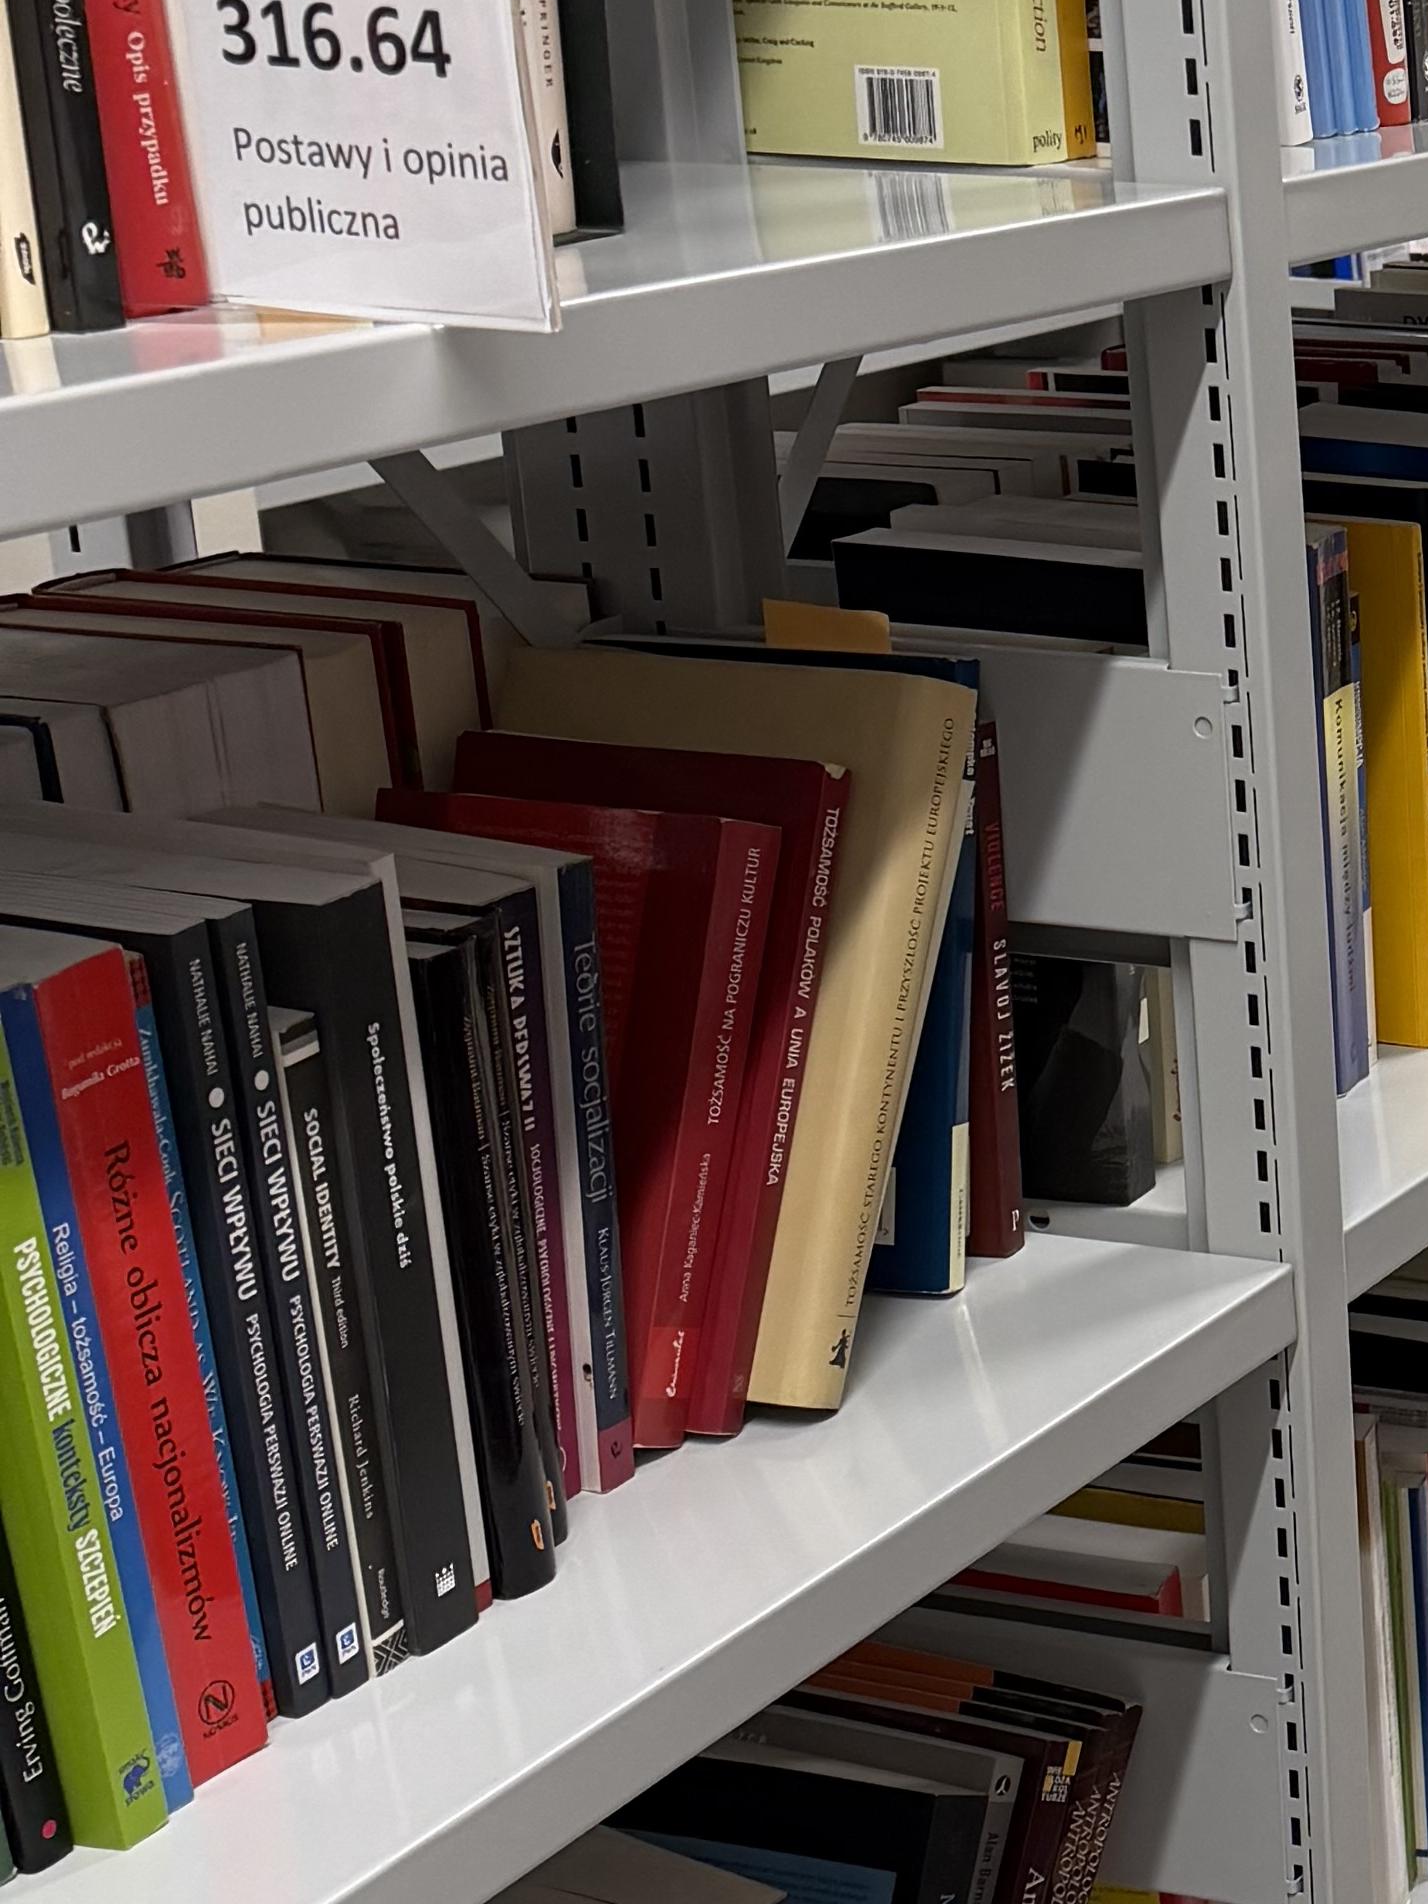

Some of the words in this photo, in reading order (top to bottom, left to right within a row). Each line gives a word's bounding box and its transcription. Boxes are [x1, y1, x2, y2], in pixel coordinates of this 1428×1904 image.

[125, 30, 147, 85] Opis
[134, 93, 168, 207] przypadku
[233, 124, 375, 184] Postawy
[380, 132, 393, 175] i
[402, 140, 510, 186] opinia
[1032, 129, 1063, 153] polity
[243, 189, 402, 242] publiczna
[811, 806, 841, 908] TOŻSAMOŚĆ
[797, 915, 822, 1000] POLAKÓW
[785, 1028, 805, 1070] UNIA
[793, 1004, 807, 1019] A
[256, 1099, 283, 1166] SIECI
[765, 1077, 796, 1187] EUROPEJSKA
[266, 1165, 301, 1283] WPŁYWU
[104, 1138, 138, 1256] Różne
[125, 1265, 162, 1387] oblicza
[150, 1396, 211, 1643] nacjonalizmów
[288, 1293, 316, 1406] PSYCHOLOGIA
[14, 1236, 73, 1422] PSYCHOLOGICZNE
[51, 1417, 92, 1533] konteksty
[74, 1527, 123, 1638] SZCZEPIEŃ
[307, 1403, 331, 1491] PERSWAZJI
[319, 1490, 339, 1551] ONLINE
